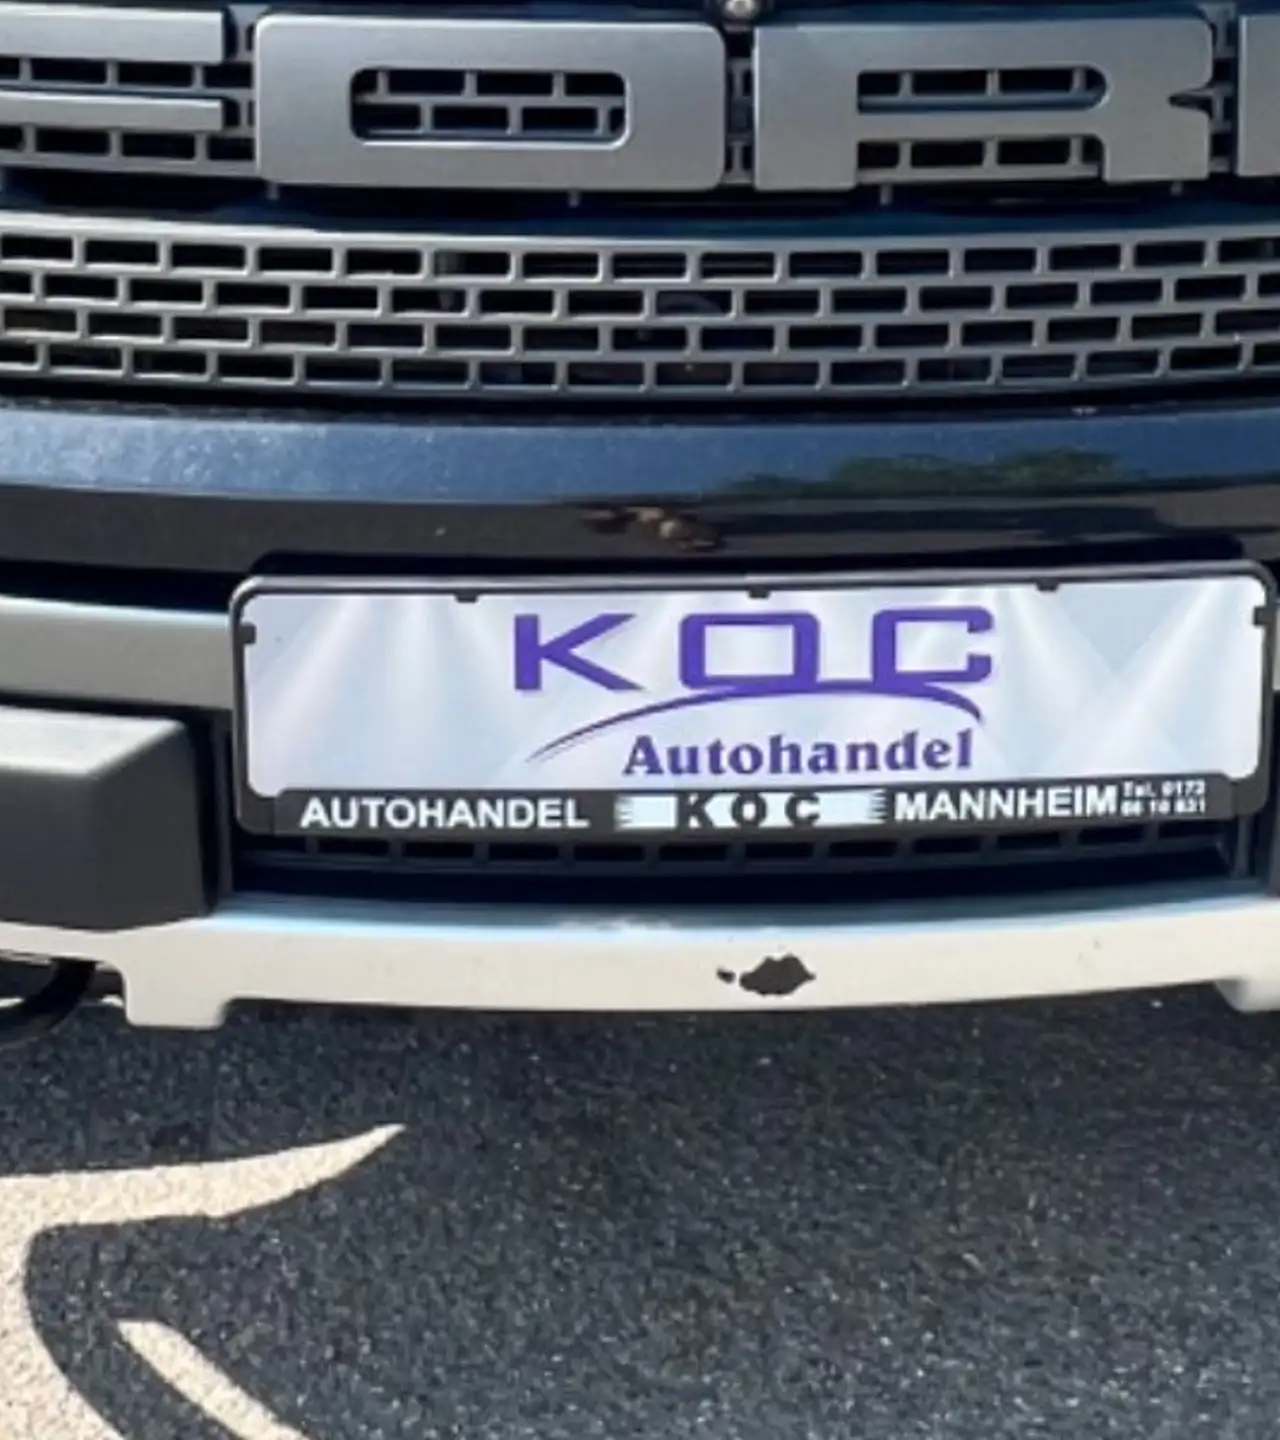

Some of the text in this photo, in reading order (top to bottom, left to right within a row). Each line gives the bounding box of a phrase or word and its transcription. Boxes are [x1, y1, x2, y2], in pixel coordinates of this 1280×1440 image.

[514, 606, 994, 692] KOC
[622, 729, 973, 776] Autohandel
[299, 785, 1117, 829] AUTOHANDEL KOC MANNHEIM
